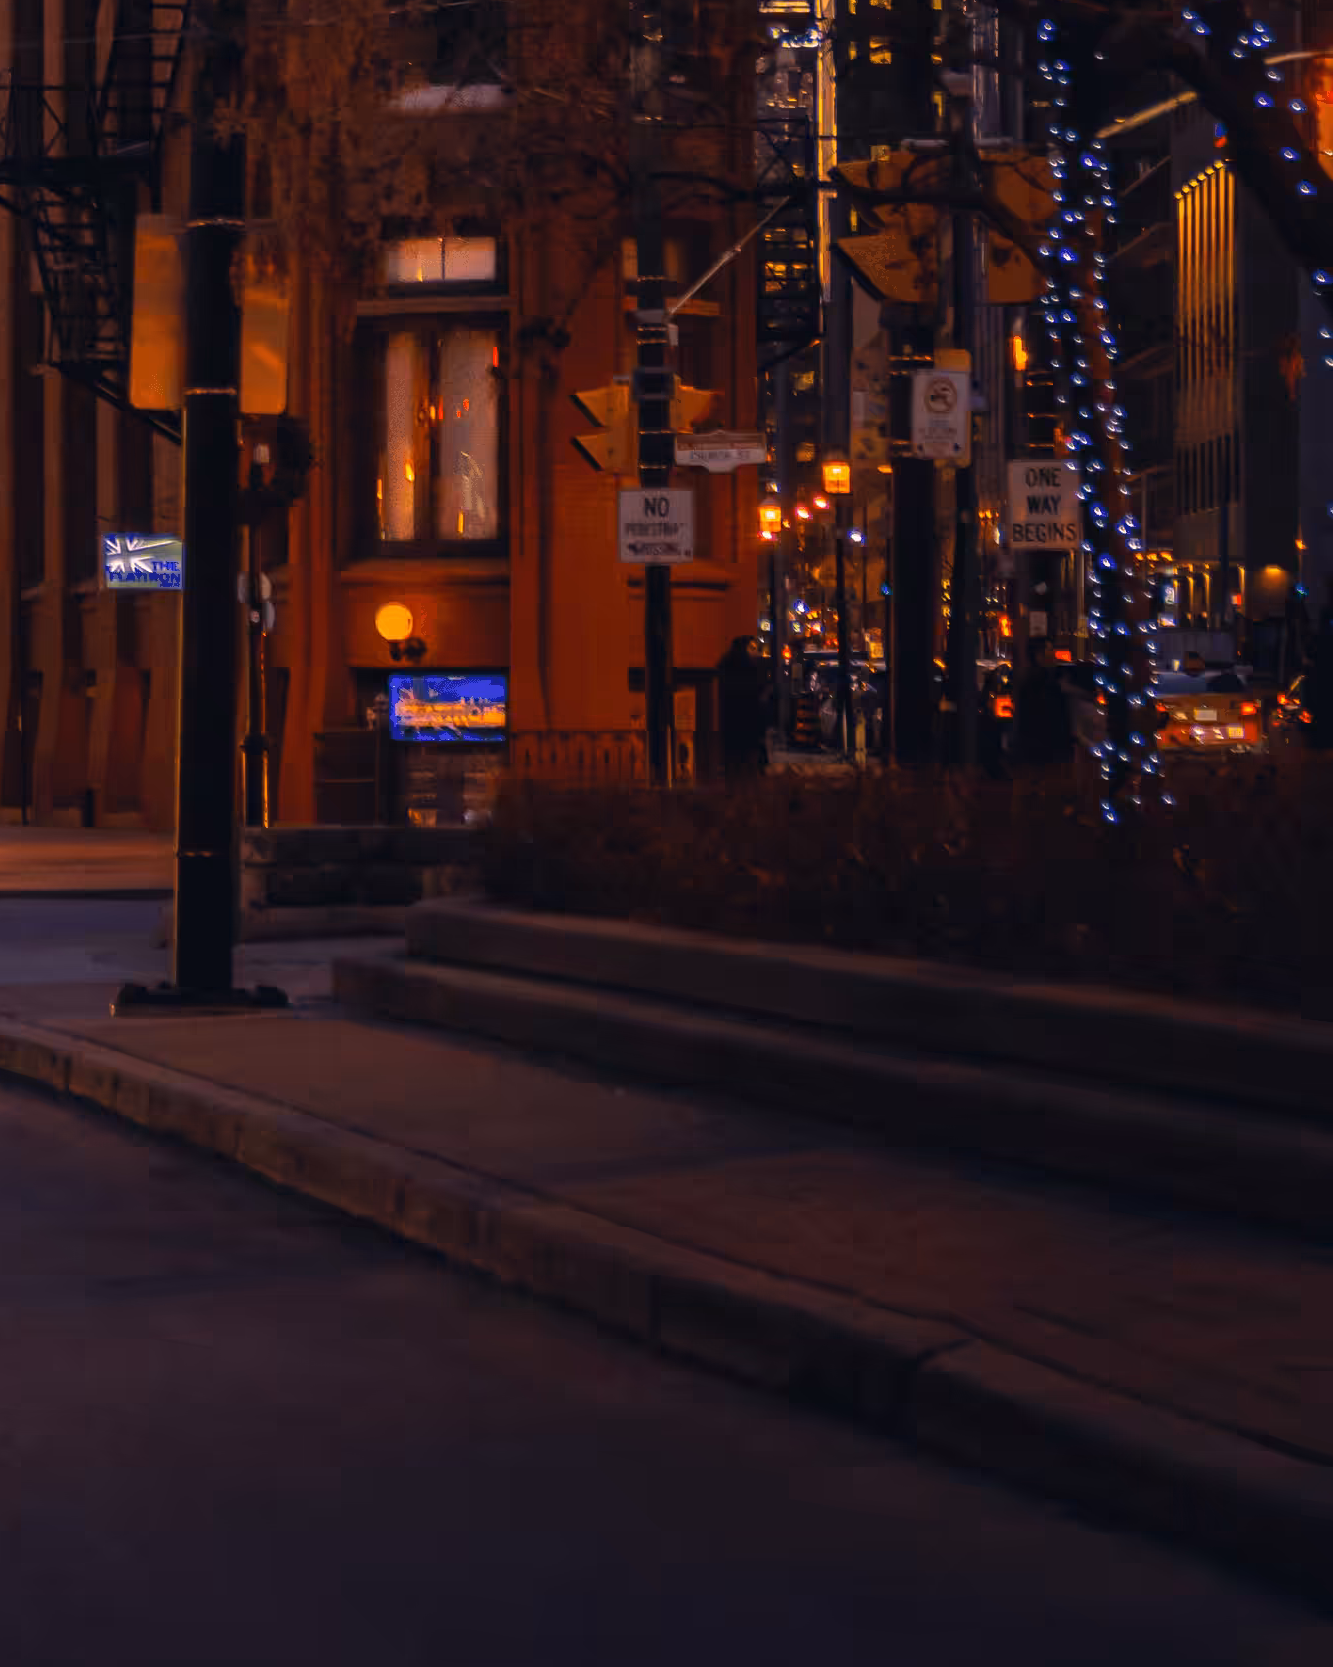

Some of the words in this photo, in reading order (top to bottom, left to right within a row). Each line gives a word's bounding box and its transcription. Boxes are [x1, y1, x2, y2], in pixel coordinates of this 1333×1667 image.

[1025, 468, 1061, 487] ONE
[644, 497, 670, 517] NO
[1027, 496, 1061, 515] WAY
[1012, 523, 1077, 543] BEGINS
[151, 561, 181, 571] THE
